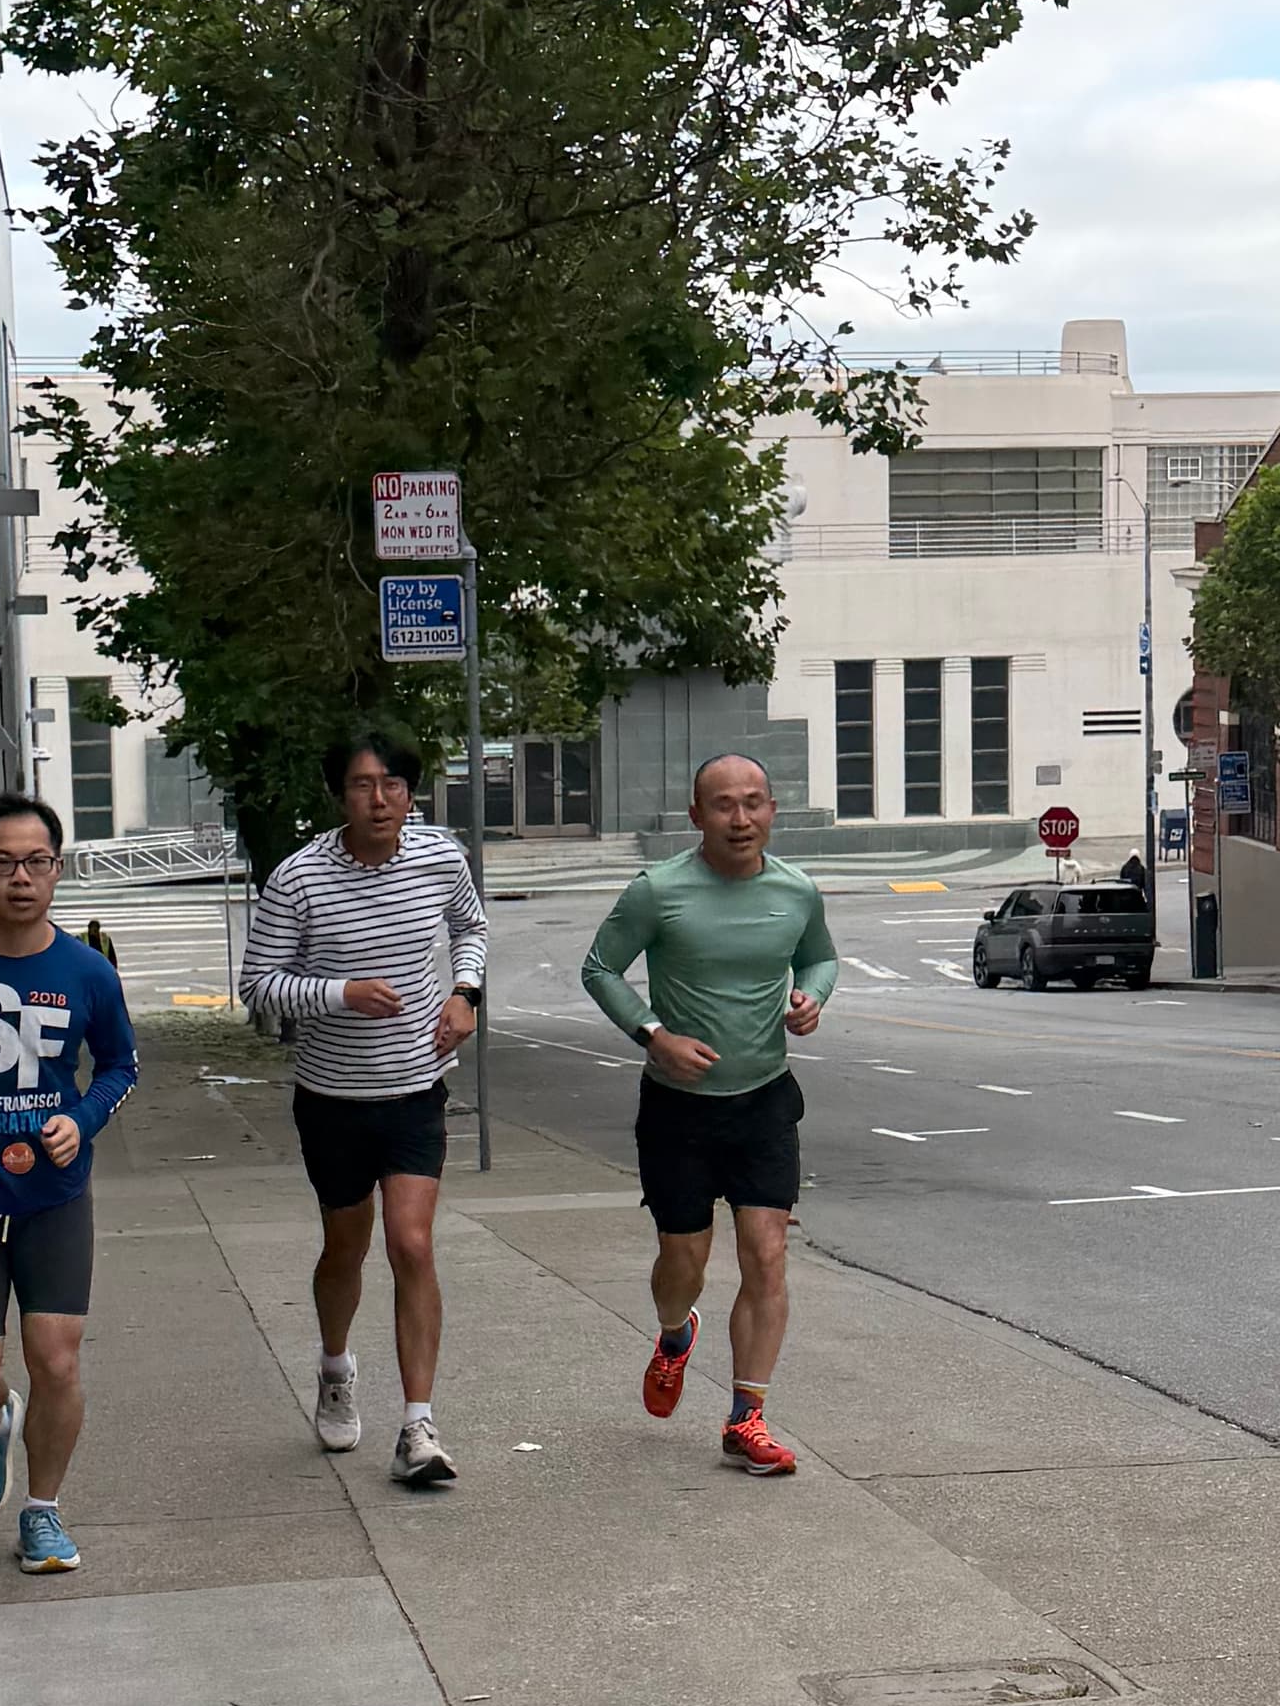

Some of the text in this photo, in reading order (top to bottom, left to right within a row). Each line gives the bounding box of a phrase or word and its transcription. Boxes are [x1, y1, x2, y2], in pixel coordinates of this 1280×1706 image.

[377, 476, 455, 498] NO PARKING
[381, 524, 455, 539] MON WED FRI
[387, 581, 437, 599] Pay by
[388, 597, 443, 611] License
[388, 611, 427, 626] Plate
[391, 628, 456, 644] 61231005
[1040, 819, 1077, 836] STOP
[29, 991, 67, 1006] 2018
